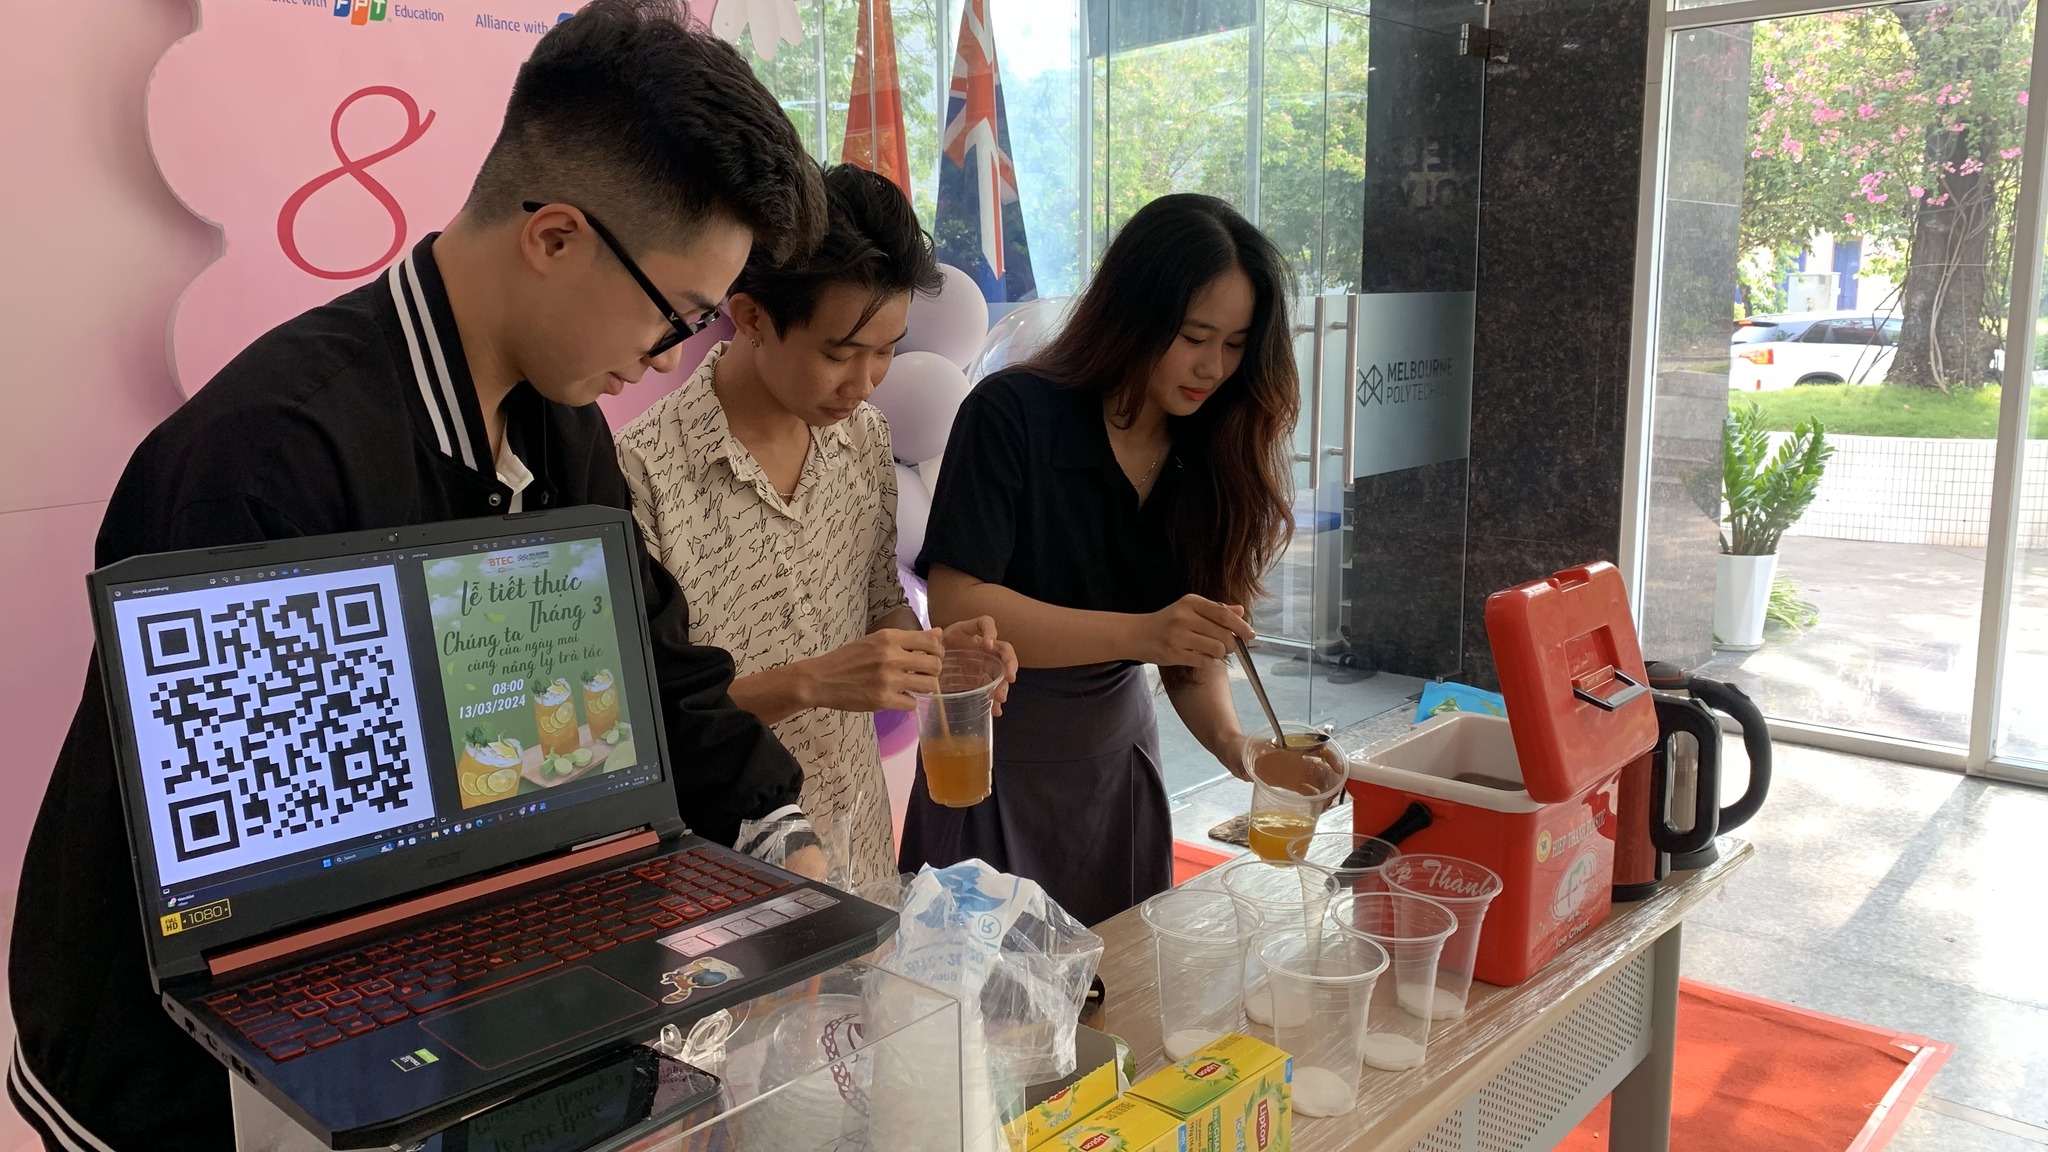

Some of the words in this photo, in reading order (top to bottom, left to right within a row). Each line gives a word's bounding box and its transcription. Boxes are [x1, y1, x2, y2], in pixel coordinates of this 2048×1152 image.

[394, 4, 445, 23] Education
[475, 13, 521, 32] Alliance
[523, 20, 550, 36] with
[277, 85, 437, 280] 8
[1387, 358, 1454, 383] MELBOURNE
[489, 555, 514, 567] BTEC
[488, 575, 527, 603] tiết
[533, 568, 582, 598] thực
[528, 599, 587, 633] Tháng
[592, 595, 603, 615] 3
[443, 630, 501, 658] Chúng
[504, 626, 524, 644] ta
[499, 642, 521, 657] của
[525, 637, 554, 658] ngày
[557, 633, 580, 646] mai
[467, 657, 498, 676] cùng
[502, 660, 537, 680] nâng
[540, 651, 555, 675] ly
[559, 650, 580, 665] trà
[492, 678, 525, 696] 08:00
[459, 694, 527, 720] 13/03/2024
[165, 917, 178, 925] FULL
[166, 922, 179, 933] HD
[188, 905, 223, 924] 1080
[1195, 1063, 1219, 1077] Lipton
[1235, 1115, 1244, 1137] ice
[1258, 1103, 1268, 1147] Lipton
[1083, 1133, 1107, 1151] Lipton
